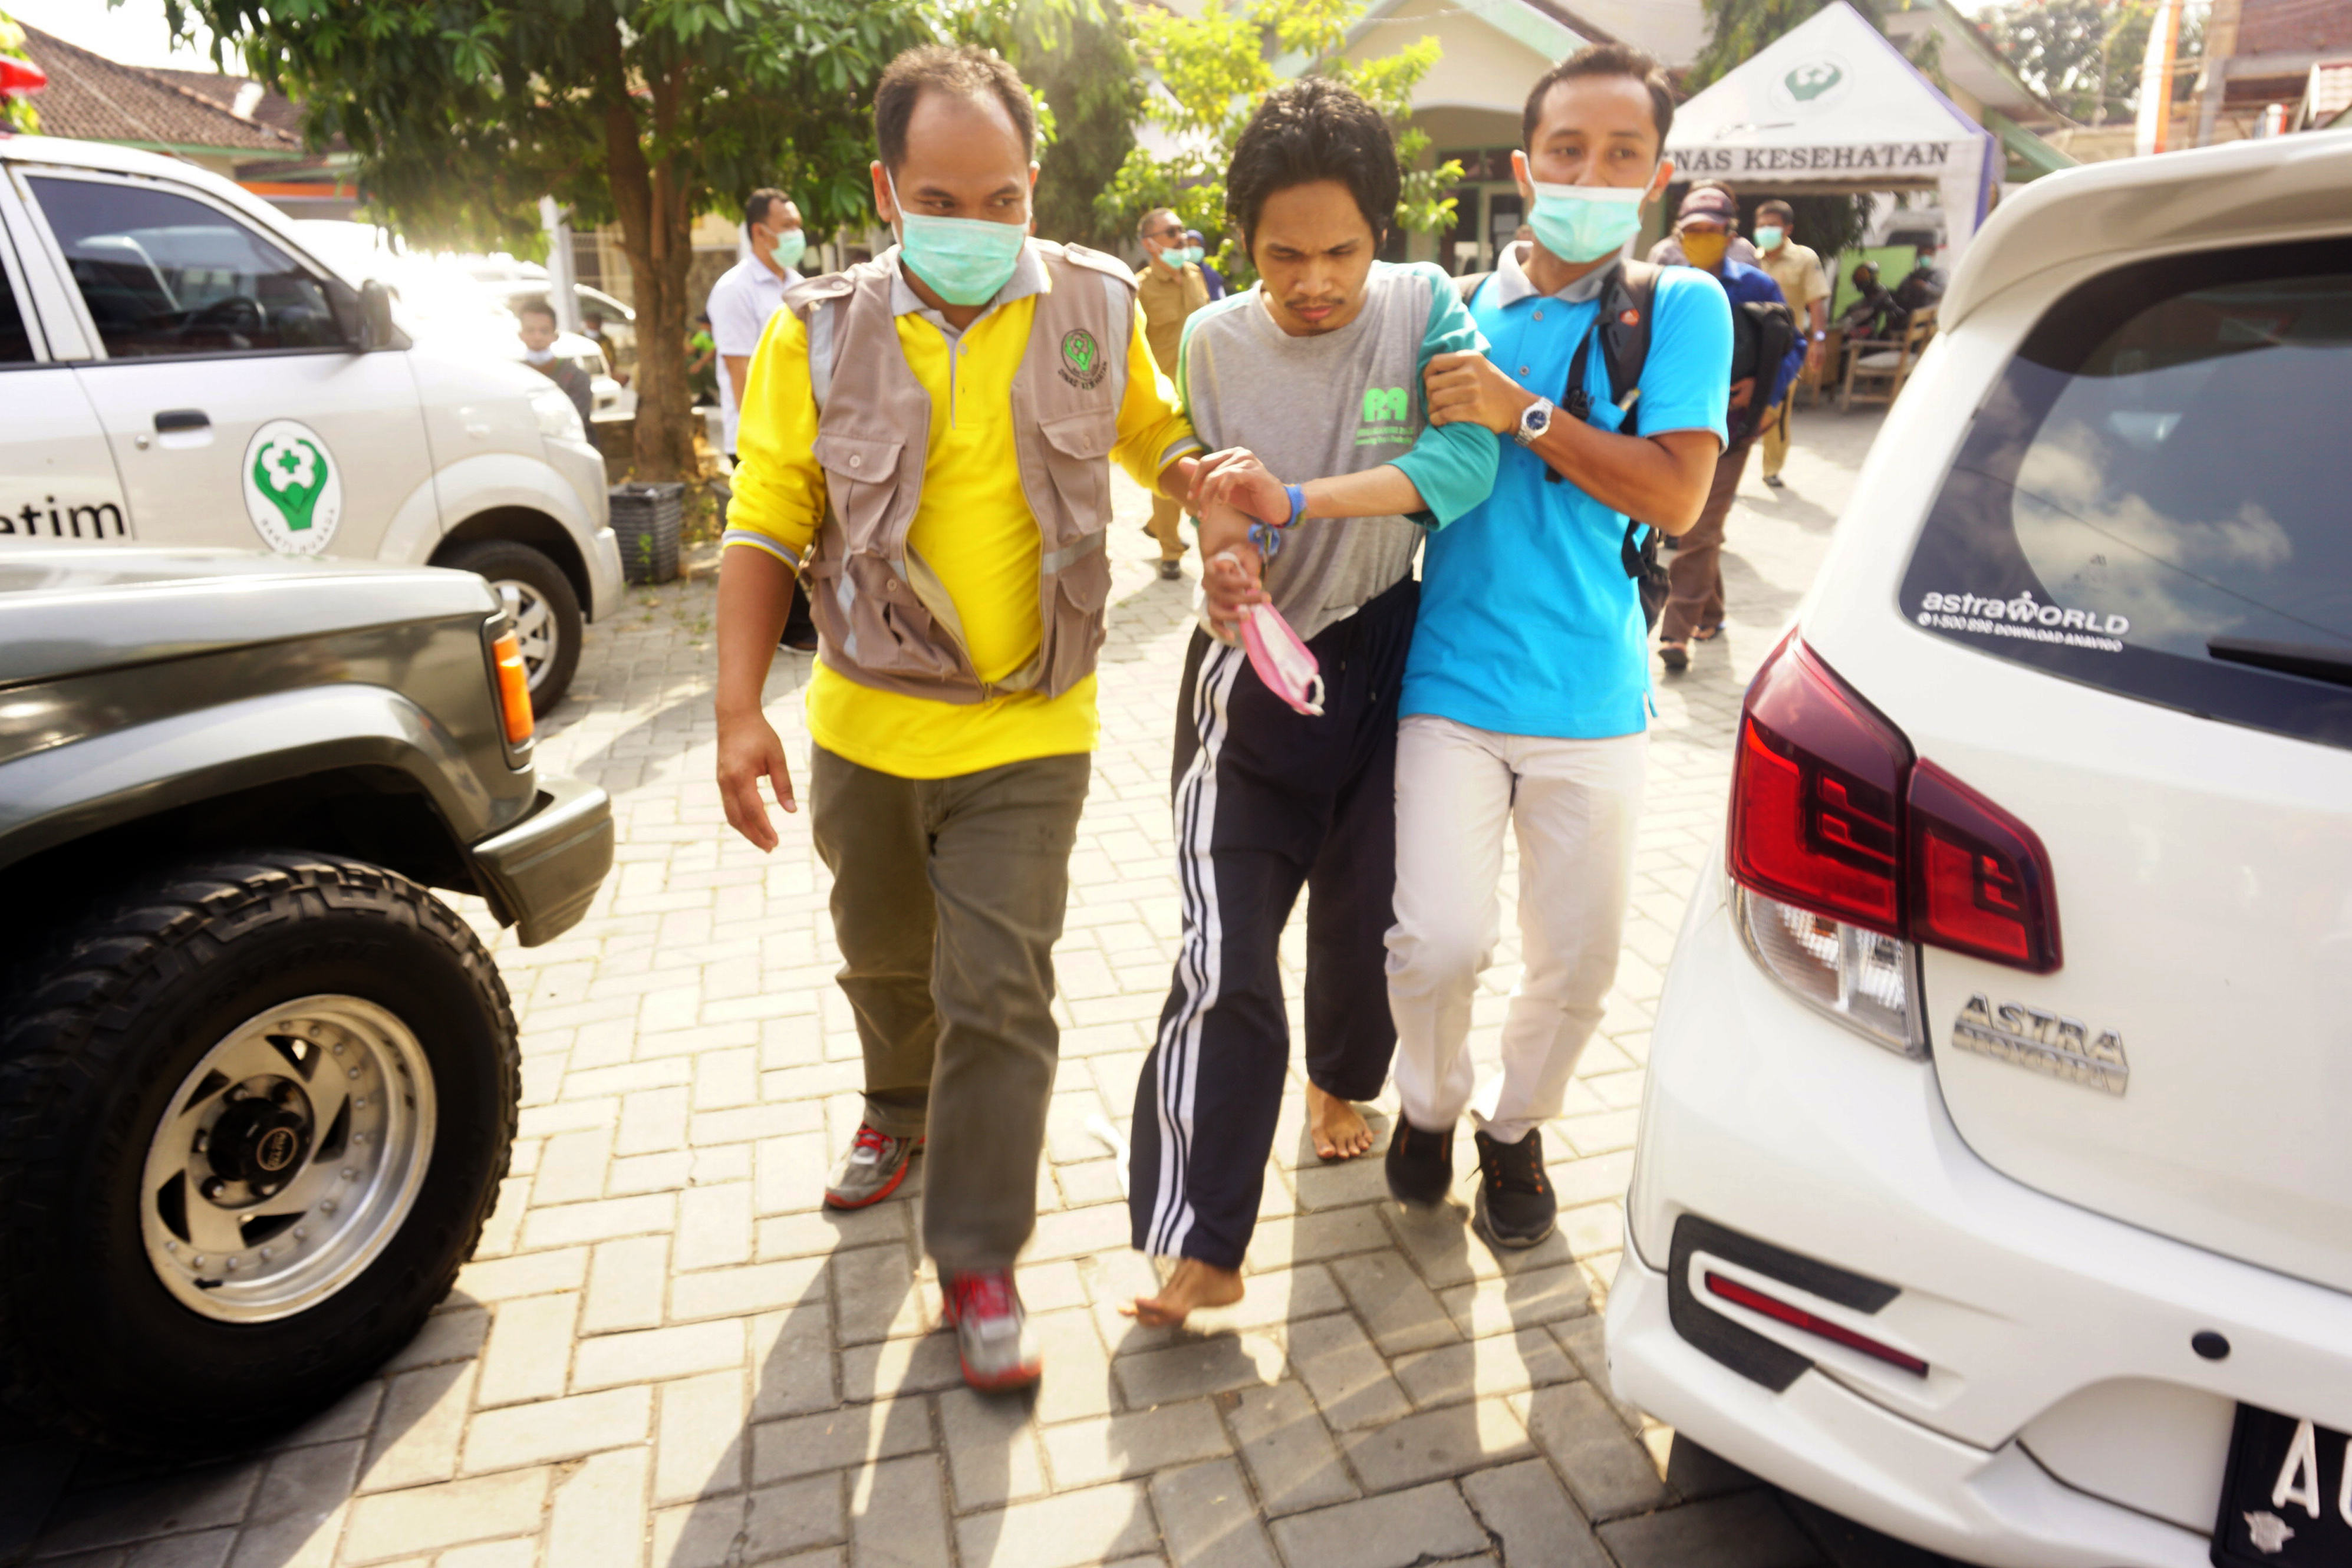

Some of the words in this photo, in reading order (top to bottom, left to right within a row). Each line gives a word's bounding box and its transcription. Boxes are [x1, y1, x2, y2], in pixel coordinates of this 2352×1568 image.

[1663, 149, 1732, 172] NAS
[1744, 143, 1949, 170] KESEHATAN
[1954, 991, 2128, 1072] ASTRA
[2271, 1417, 2352, 1528] A
